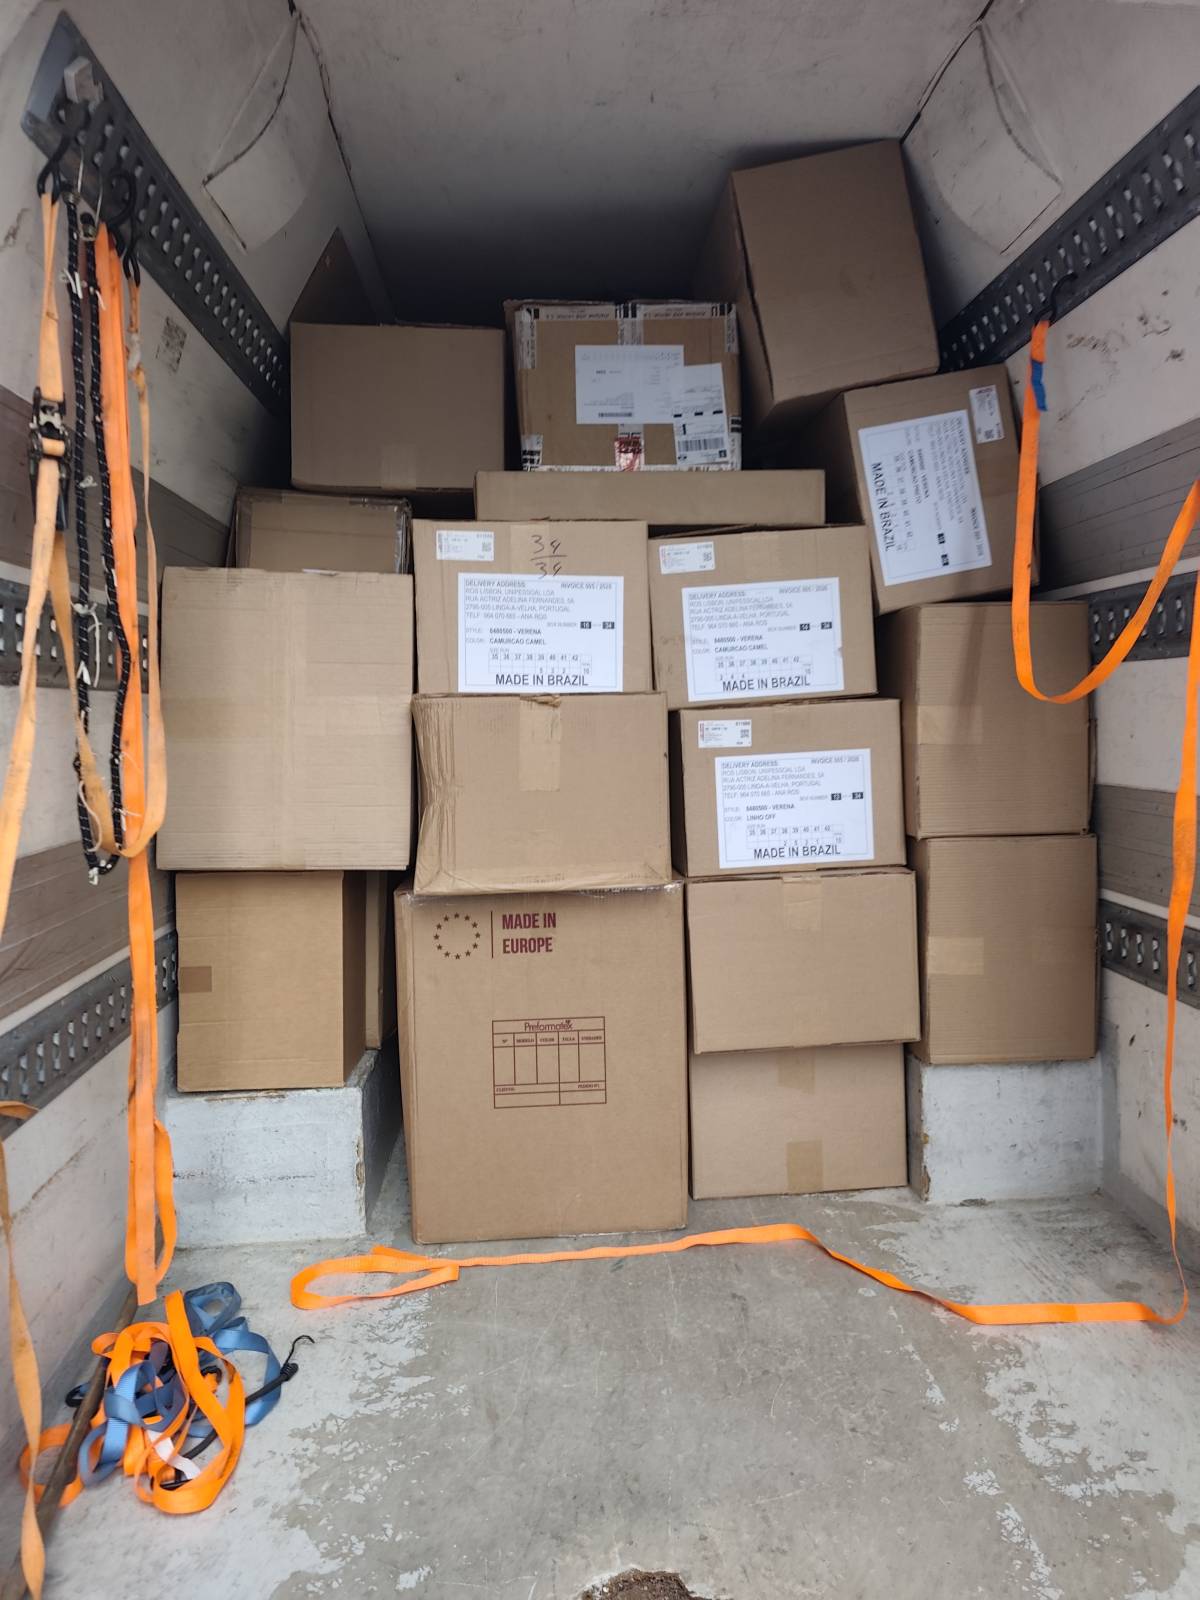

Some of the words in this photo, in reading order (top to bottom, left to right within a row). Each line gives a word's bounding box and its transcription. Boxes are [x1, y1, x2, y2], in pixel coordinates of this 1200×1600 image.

[872, 462, 886, 496] MADE
[877, 497, 889, 509] IN
[880, 512, 896, 552] BRAZIL
[496, 674, 529, 685] MADE
[533, 674, 544, 685] IN
[548, 674, 588, 686] BRAZIL
[722, 680, 754, 692] MADE
[757, 678, 768, 689] IN
[771, 675, 810, 688] BRAZIL
[754, 848, 785, 859] MADE
[788, 846, 799, 857] IN
[802, 844, 841, 856] BRAZIL
[502, 913, 540, 930] MADE
[544, 912, 556, 928] IN
[502, 937, 553, 954] EUROPE
